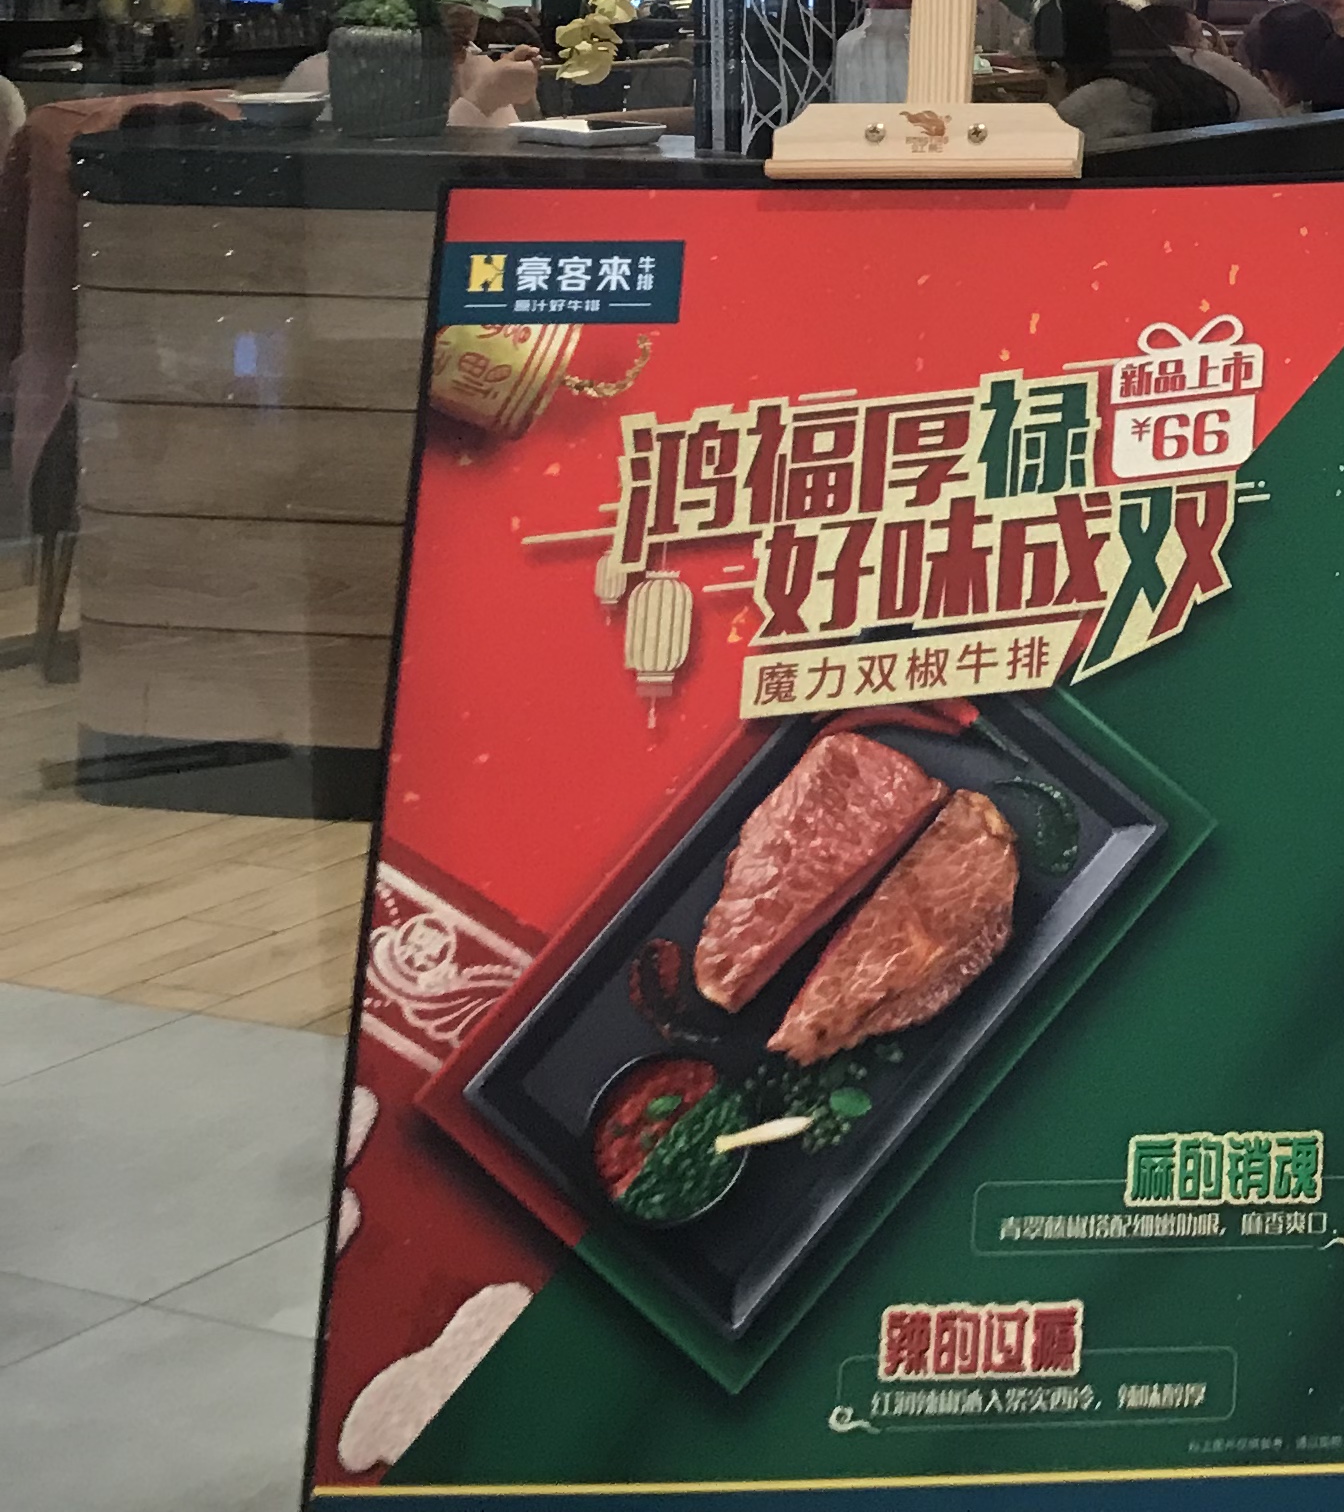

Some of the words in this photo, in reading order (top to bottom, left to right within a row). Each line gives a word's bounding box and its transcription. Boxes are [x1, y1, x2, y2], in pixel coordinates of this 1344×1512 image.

[515, 255, 632, 292] 豪客來
[1119, 348, 1256, 399] 新品上市
[620, 378, 1089, 565] 鸿福厚禄
[761, 482, 1231, 670] 好味成双
[753, 638, 1052, 706] 魔力双椒牛排
[1130, 1137, 1319, 1201] 麻的销魂
